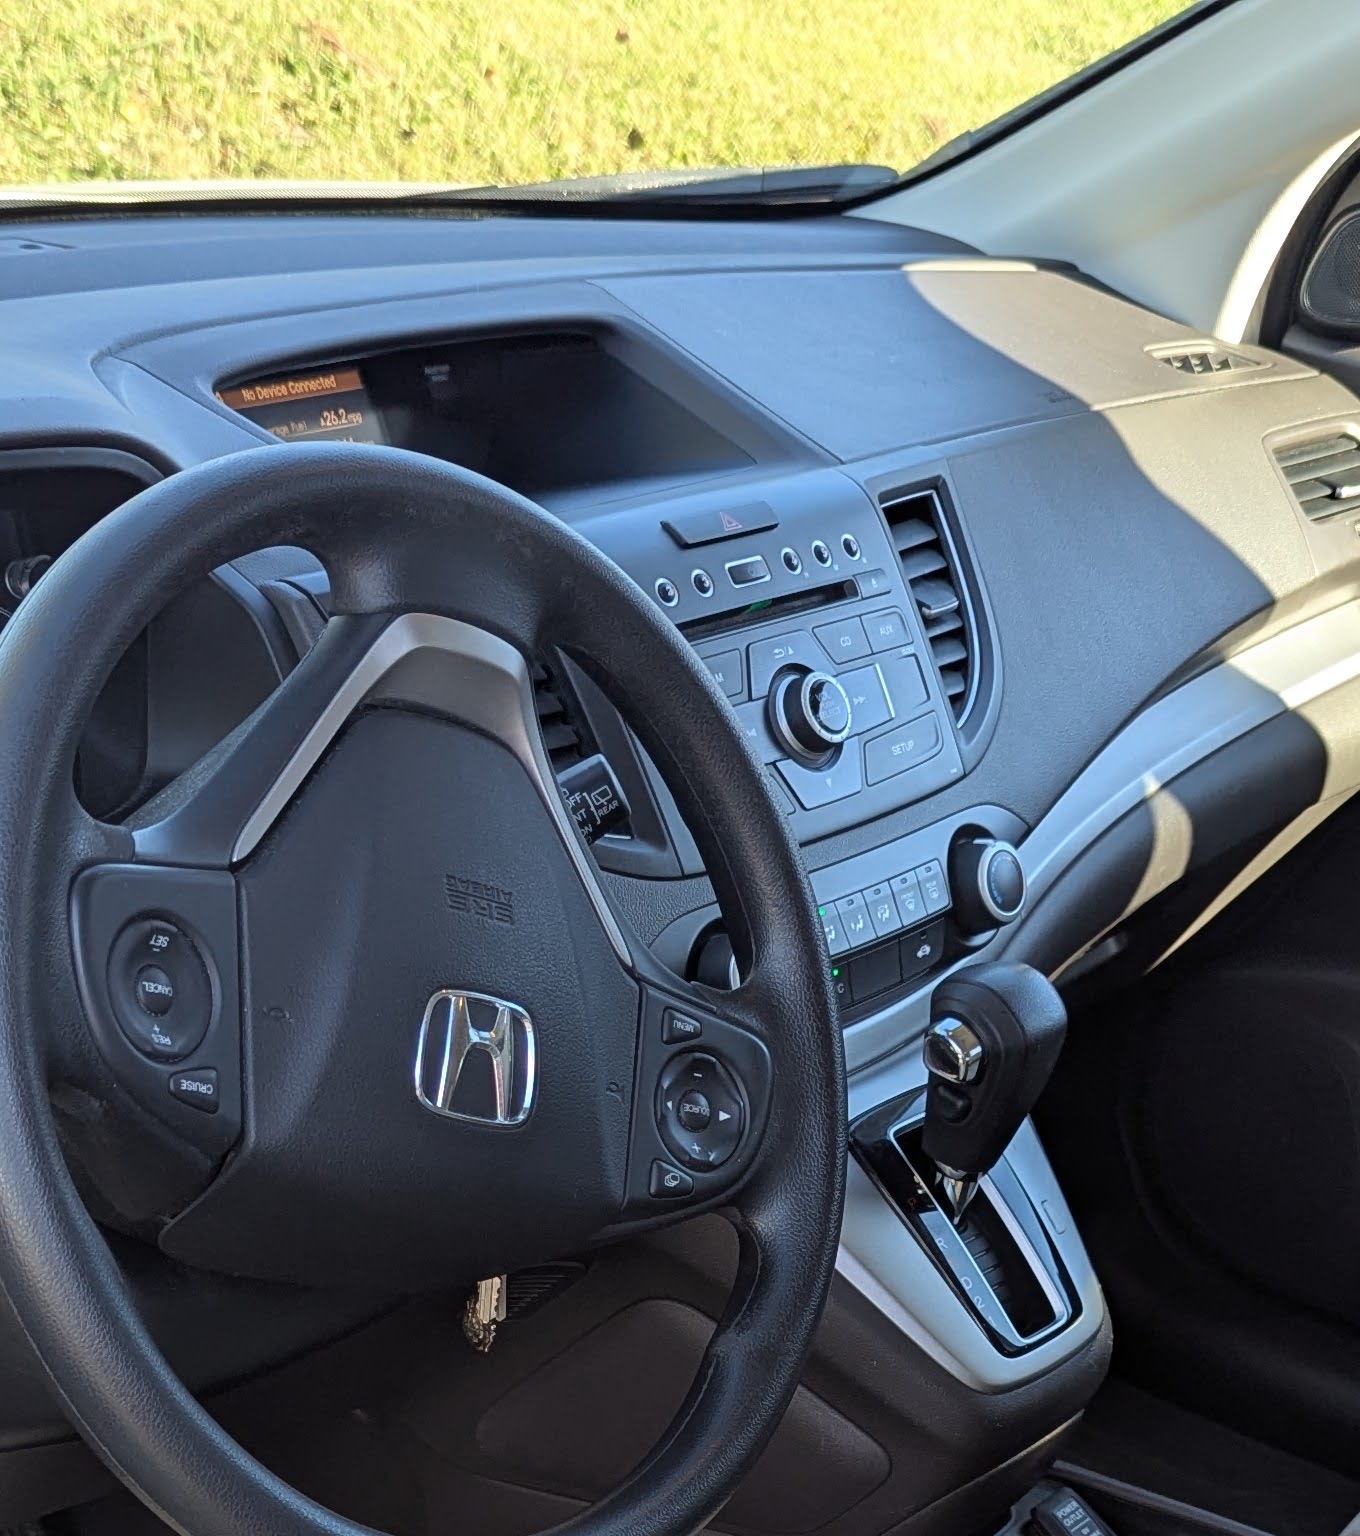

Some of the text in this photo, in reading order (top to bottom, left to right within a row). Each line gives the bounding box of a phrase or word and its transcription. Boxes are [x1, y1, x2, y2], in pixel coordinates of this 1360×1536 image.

[241, 374, 337, 402] No Device Connected
[891, 740, 915, 756] SETUP
[572, 808, 587, 821] NT
[597, 800, 620, 817] REAR
[149, 934, 170, 947] SET
[142, 981, 173, 997] CANCEL
[673, 1020, 694, 1033] MENU
[180, 1079, 214, 1095] CRUISE
[683, 1103, 710, 1118] SOURCE
[935, 1237, 948, 1249] R
[961, 1276, 973, 1290] D
[974, 1295, 985, 1309] 2
[1056, 1500, 1079, 1518] POWER
